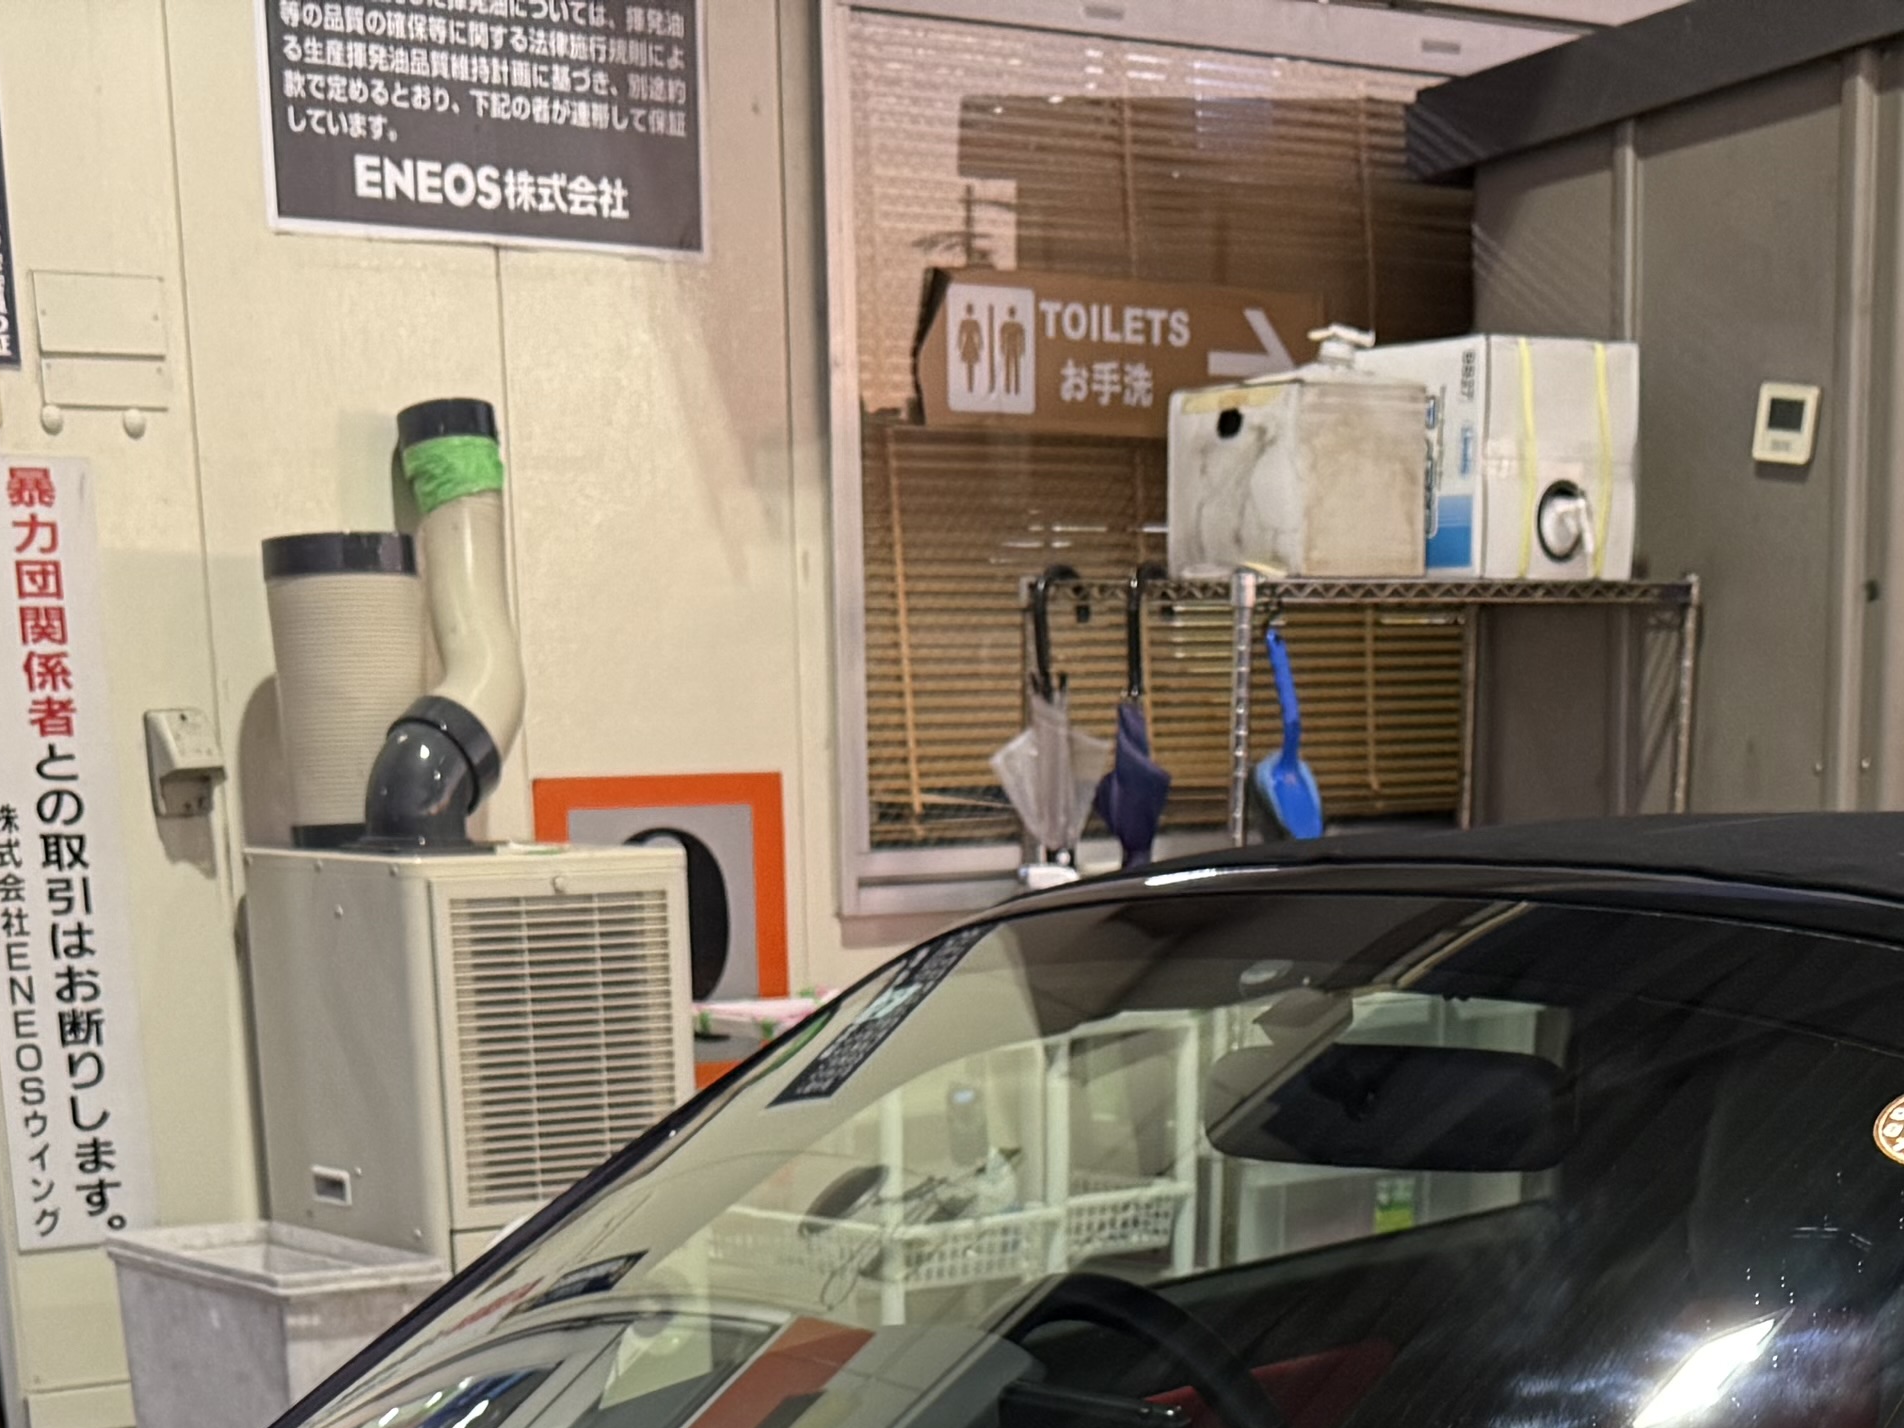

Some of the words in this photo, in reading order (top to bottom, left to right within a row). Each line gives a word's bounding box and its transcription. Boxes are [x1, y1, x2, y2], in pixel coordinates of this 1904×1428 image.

[287, 106, 398, 142] しています。
[1038, 300, 1192, 348] TOILETS
[1059, 358, 1155, 408] お手洗
[5, 466, 128, 1232] 暴力団関係者との取引はお断りします。
